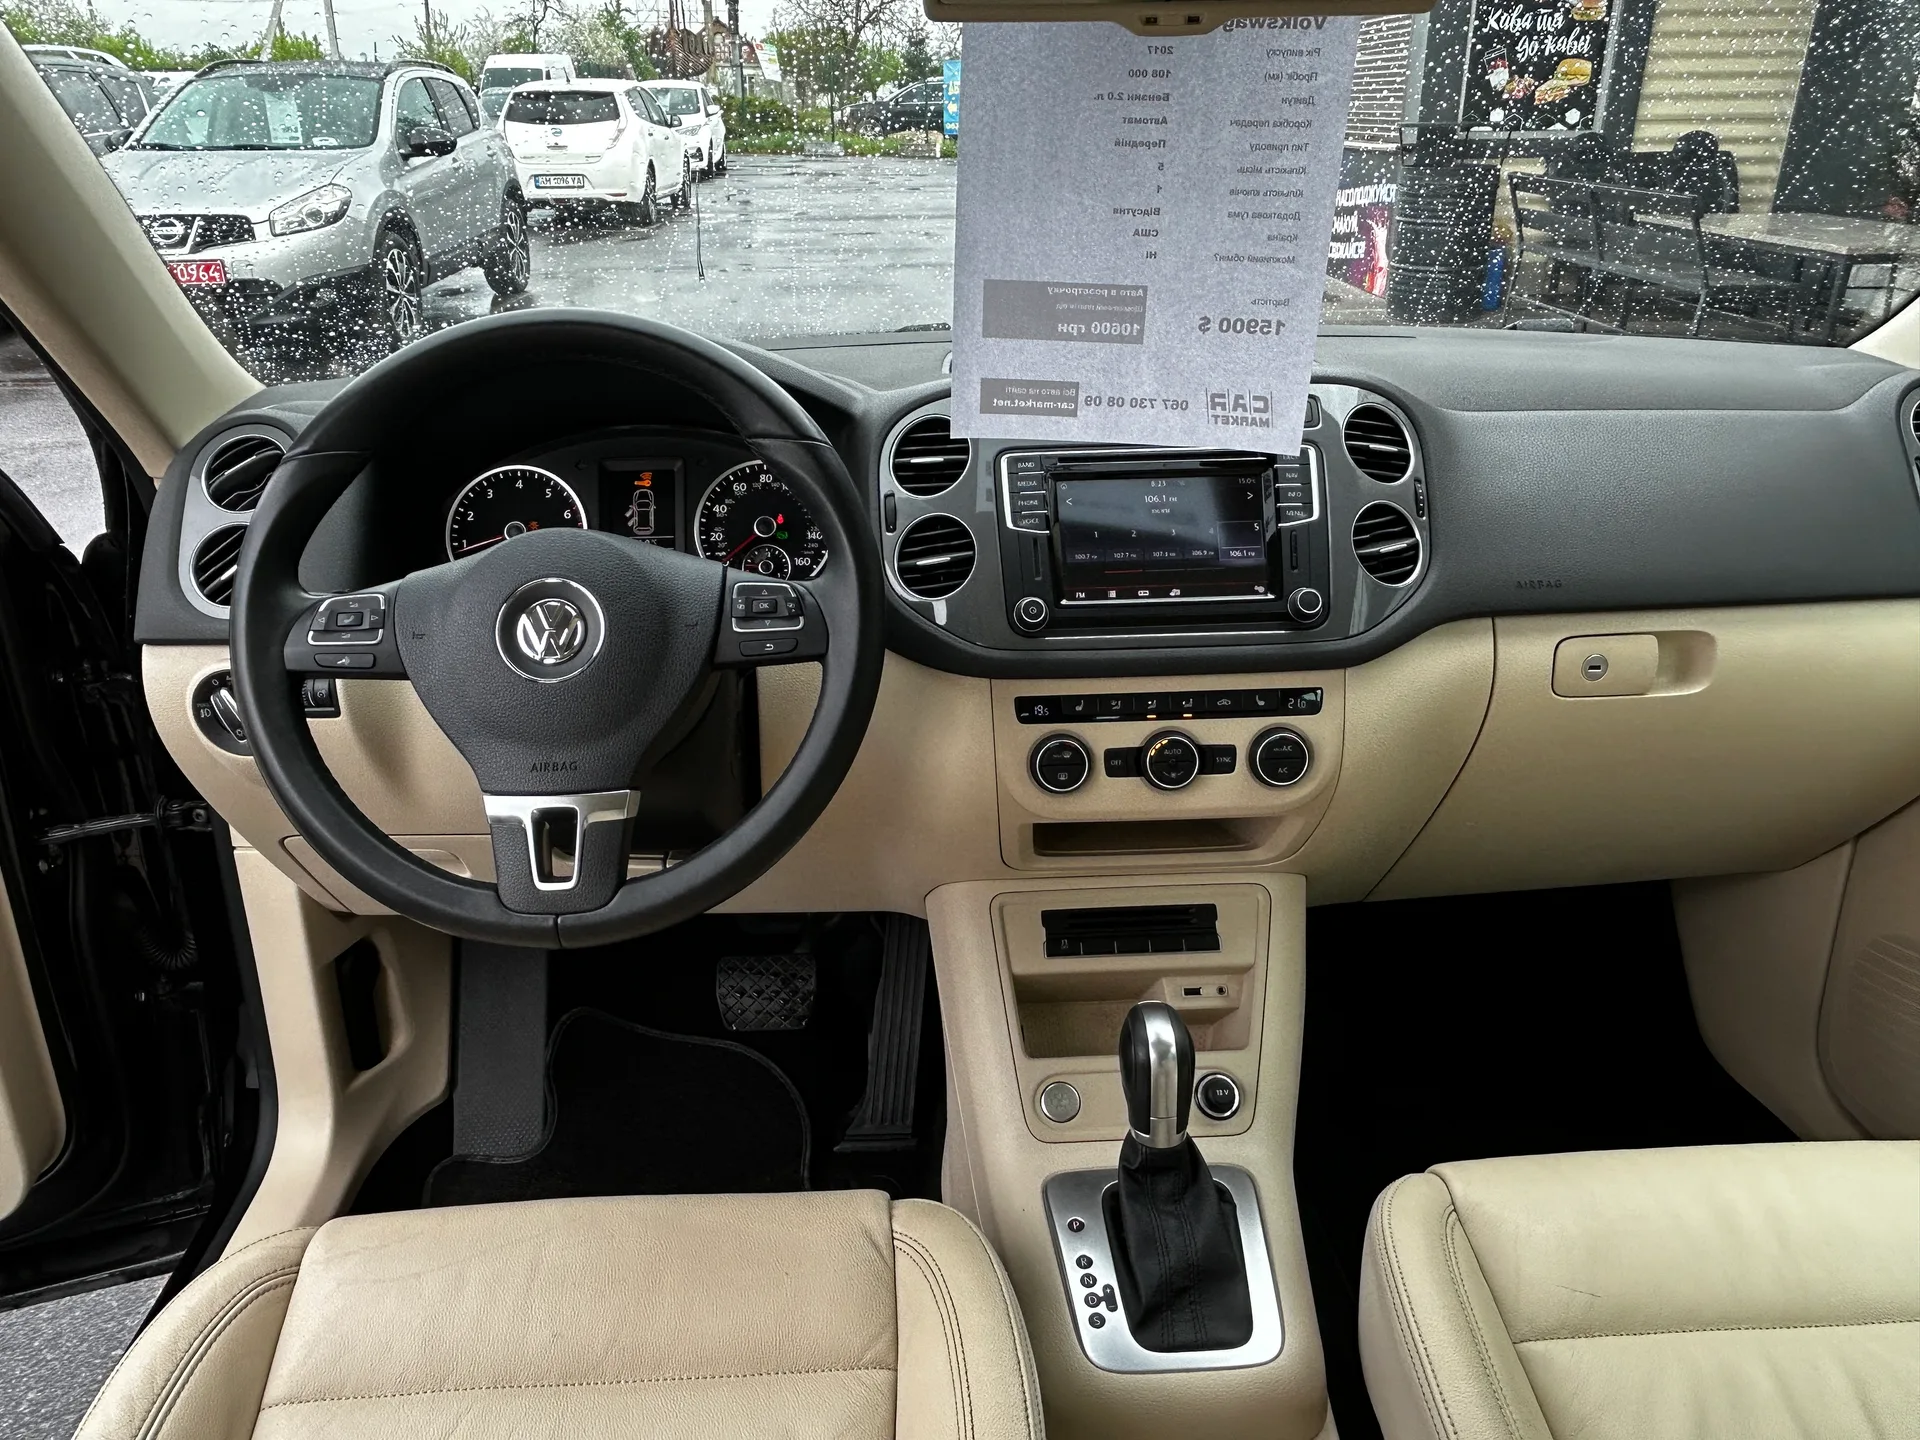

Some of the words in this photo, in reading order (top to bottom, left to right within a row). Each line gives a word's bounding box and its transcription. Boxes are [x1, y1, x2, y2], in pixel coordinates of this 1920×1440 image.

[759, 473, 773, 483] 80
[515, 479, 524, 489] 4
[733, 482, 747, 491] 60
[486, 488, 494, 499] 3
[545, 488, 552, 498] 5
[1144, 494, 1167, 503] 106.1
[712, 504, 728, 513] 40
[467, 511, 474, 521] 2
[563, 509, 572, 519] 6
[1253, 522, 1260, 531] 5
[710, 532, 723, 541] 20
[1131, 529, 1137, 538] 2
[462, 539, 467, 548] 1
[794, 557, 811, 566] 160
[1516, 579, 1562, 589] AIRBAG
[1163, 748, 1182, 756] AUTO
[530, 761, 578, 773] AIRBAG
[1072, 1220, 1080, 1230] P
[1080, 1257, 1088, 1267] R
[1084, 1275, 1093, 1285] N
[1088, 1295, 1097, 1305] D
[1093, 1315, 1101, 1326] S
